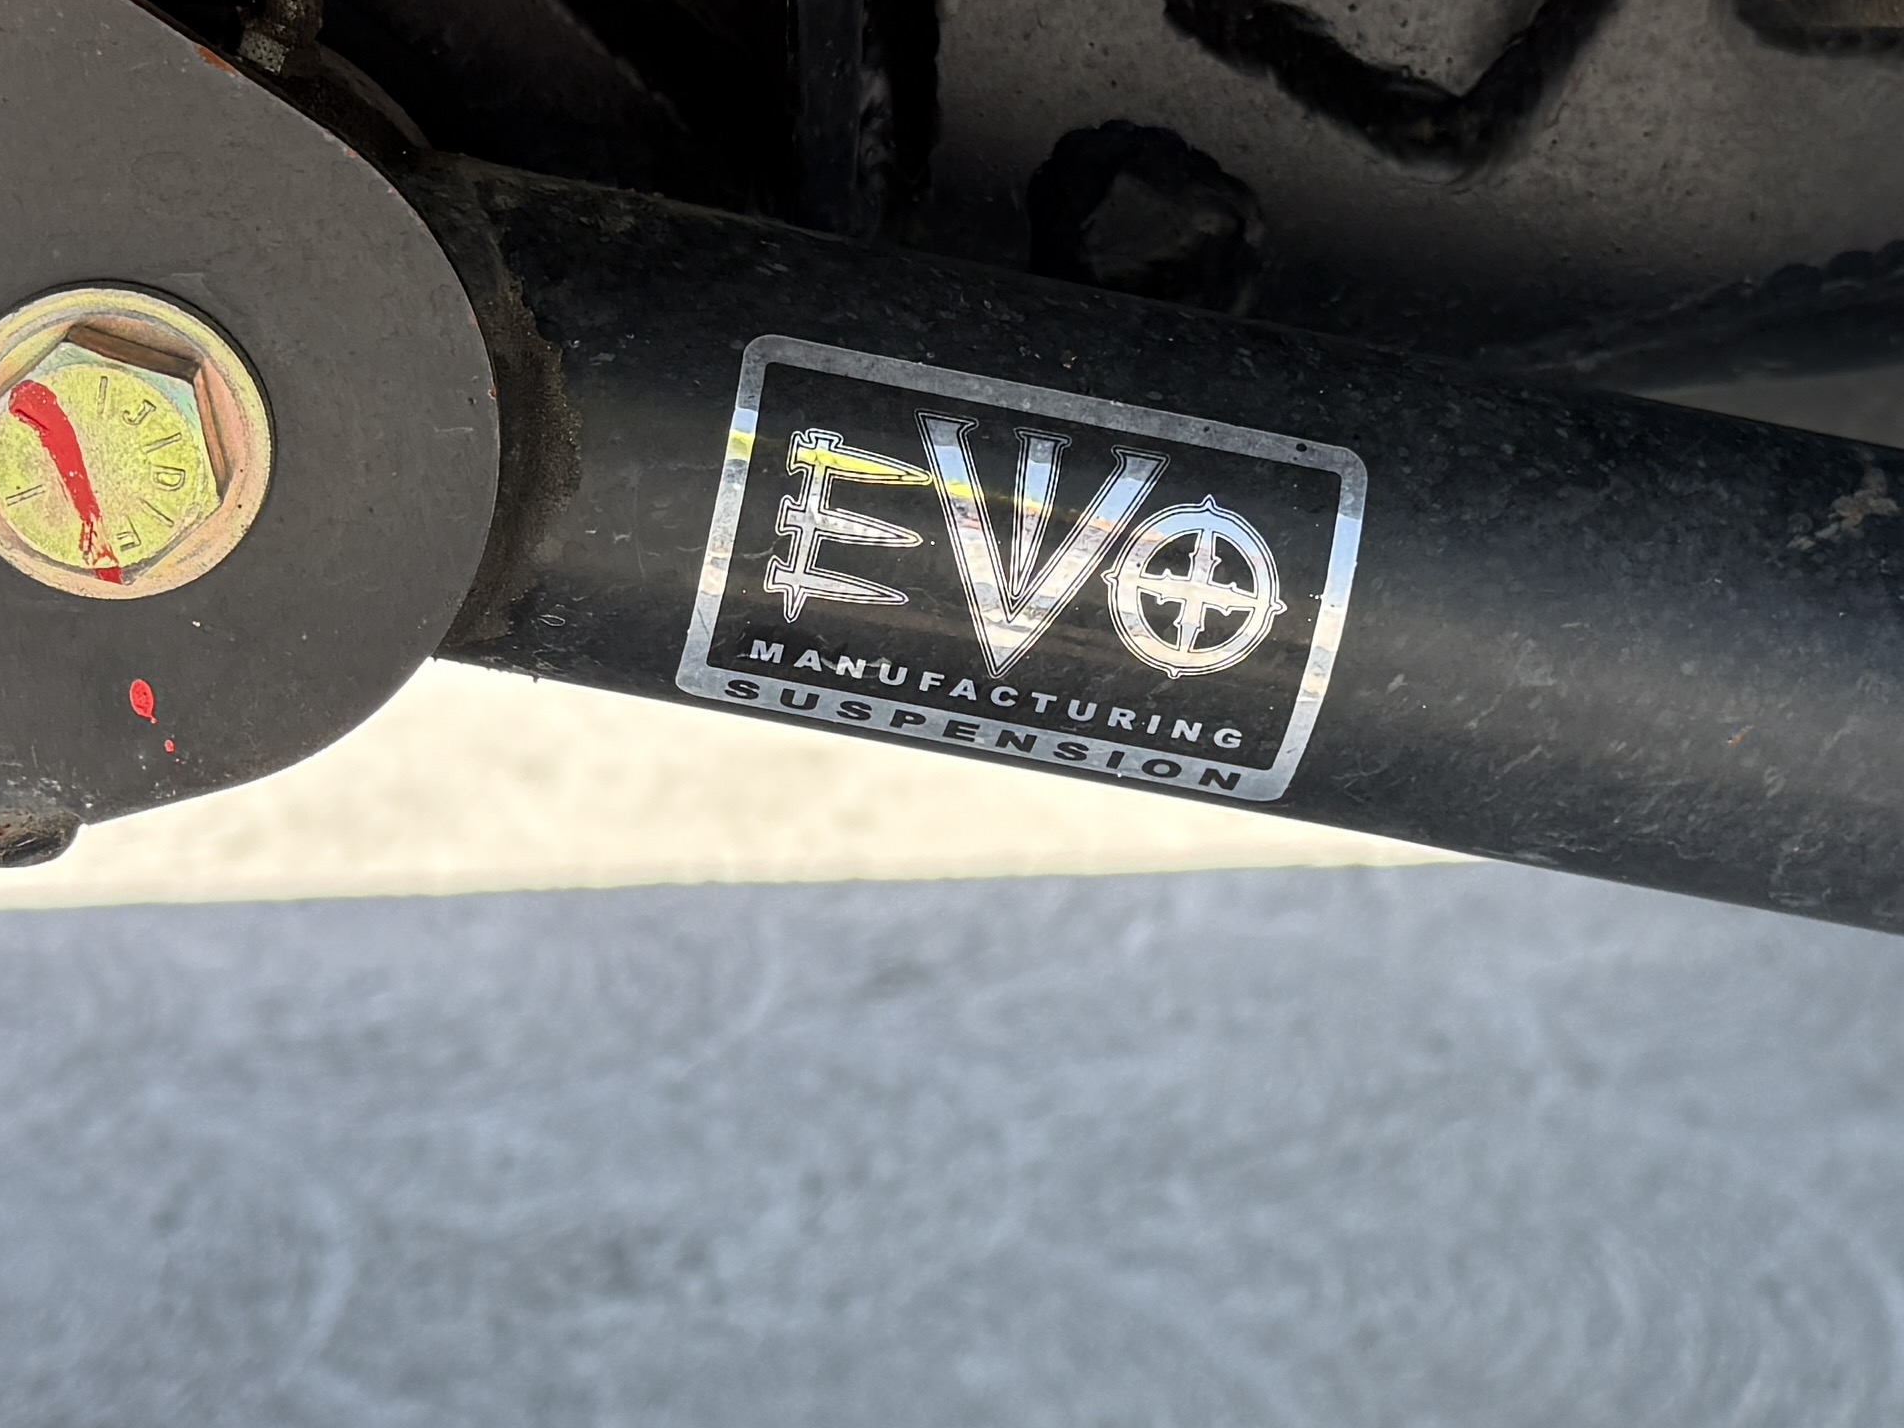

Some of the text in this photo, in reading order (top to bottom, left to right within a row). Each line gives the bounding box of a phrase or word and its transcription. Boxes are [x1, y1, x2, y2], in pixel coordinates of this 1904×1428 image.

[763, 409, 1288, 679] EVO
[724, 679, 1243, 792] SUSPENSION
[749, 638, 1245, 750] MANUFACTURING
